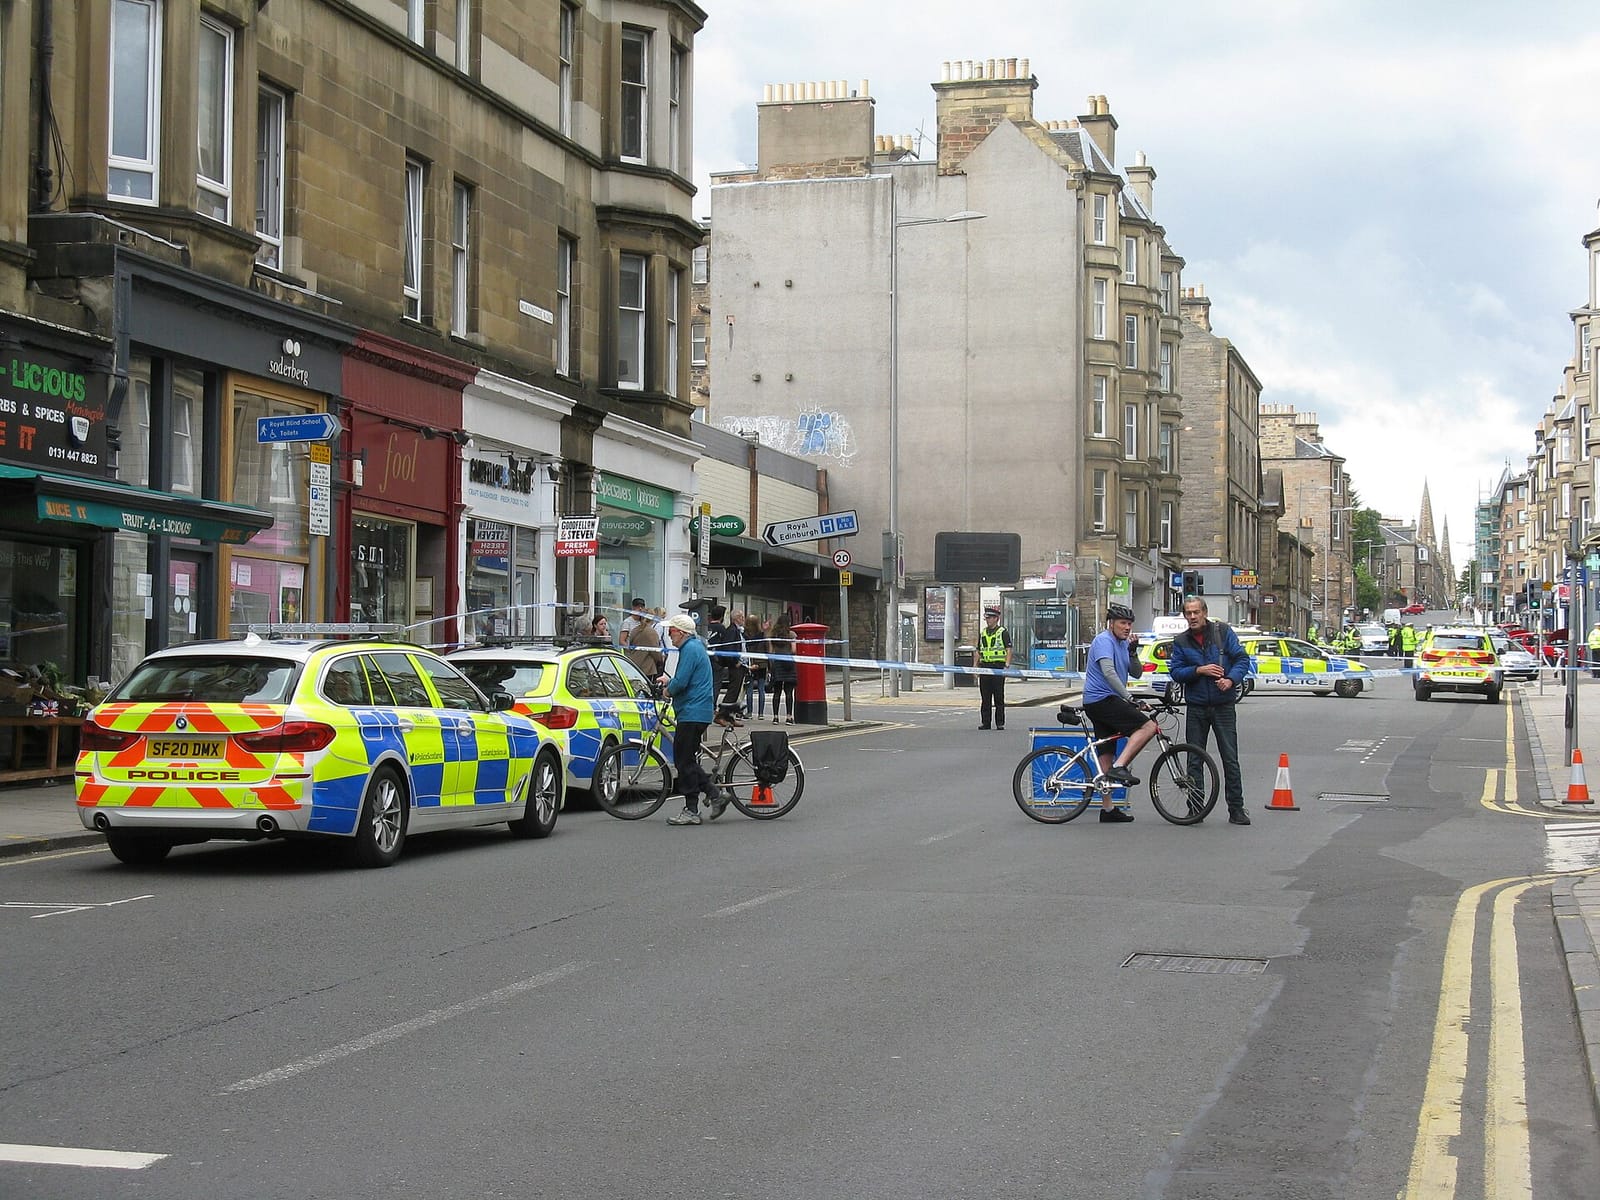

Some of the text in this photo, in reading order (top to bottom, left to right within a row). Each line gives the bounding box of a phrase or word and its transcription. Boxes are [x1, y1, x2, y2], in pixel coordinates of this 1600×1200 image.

[22, 403, 30, 416] &
[35, 406, 65, 424] SPICES
[269, 420, 285, 428] Royal
[19, 425, 37, 451] IT
[48, 446, 98, 465] 0131 447 8823
[379, 431, 419, 493] fool
[597, 480, 632, 501] Specsavers
[46, 501, 88, 519] JUICE IT
[561, 521, 596, 530] GOODFELLOW
[693, 520, 738, 529] Scsavers
[786, 521, 809, 531] Royal
[821, 520, 833, 533] H
[567, 530, 595, 540] STEVEN
[780, 528, 819, 541] Edinburgh
[835, 554, 849, 563] 20
[702, 578, 719, 586] M&S
[841, 571, 850, 583] H
[1432, 670, 1483, 678] POLICE
[1265, 677, 1329, 686] POLICE
[152, 742, 219, 756] SF20 DMX
[127, 770, 240, 781] POLICE
